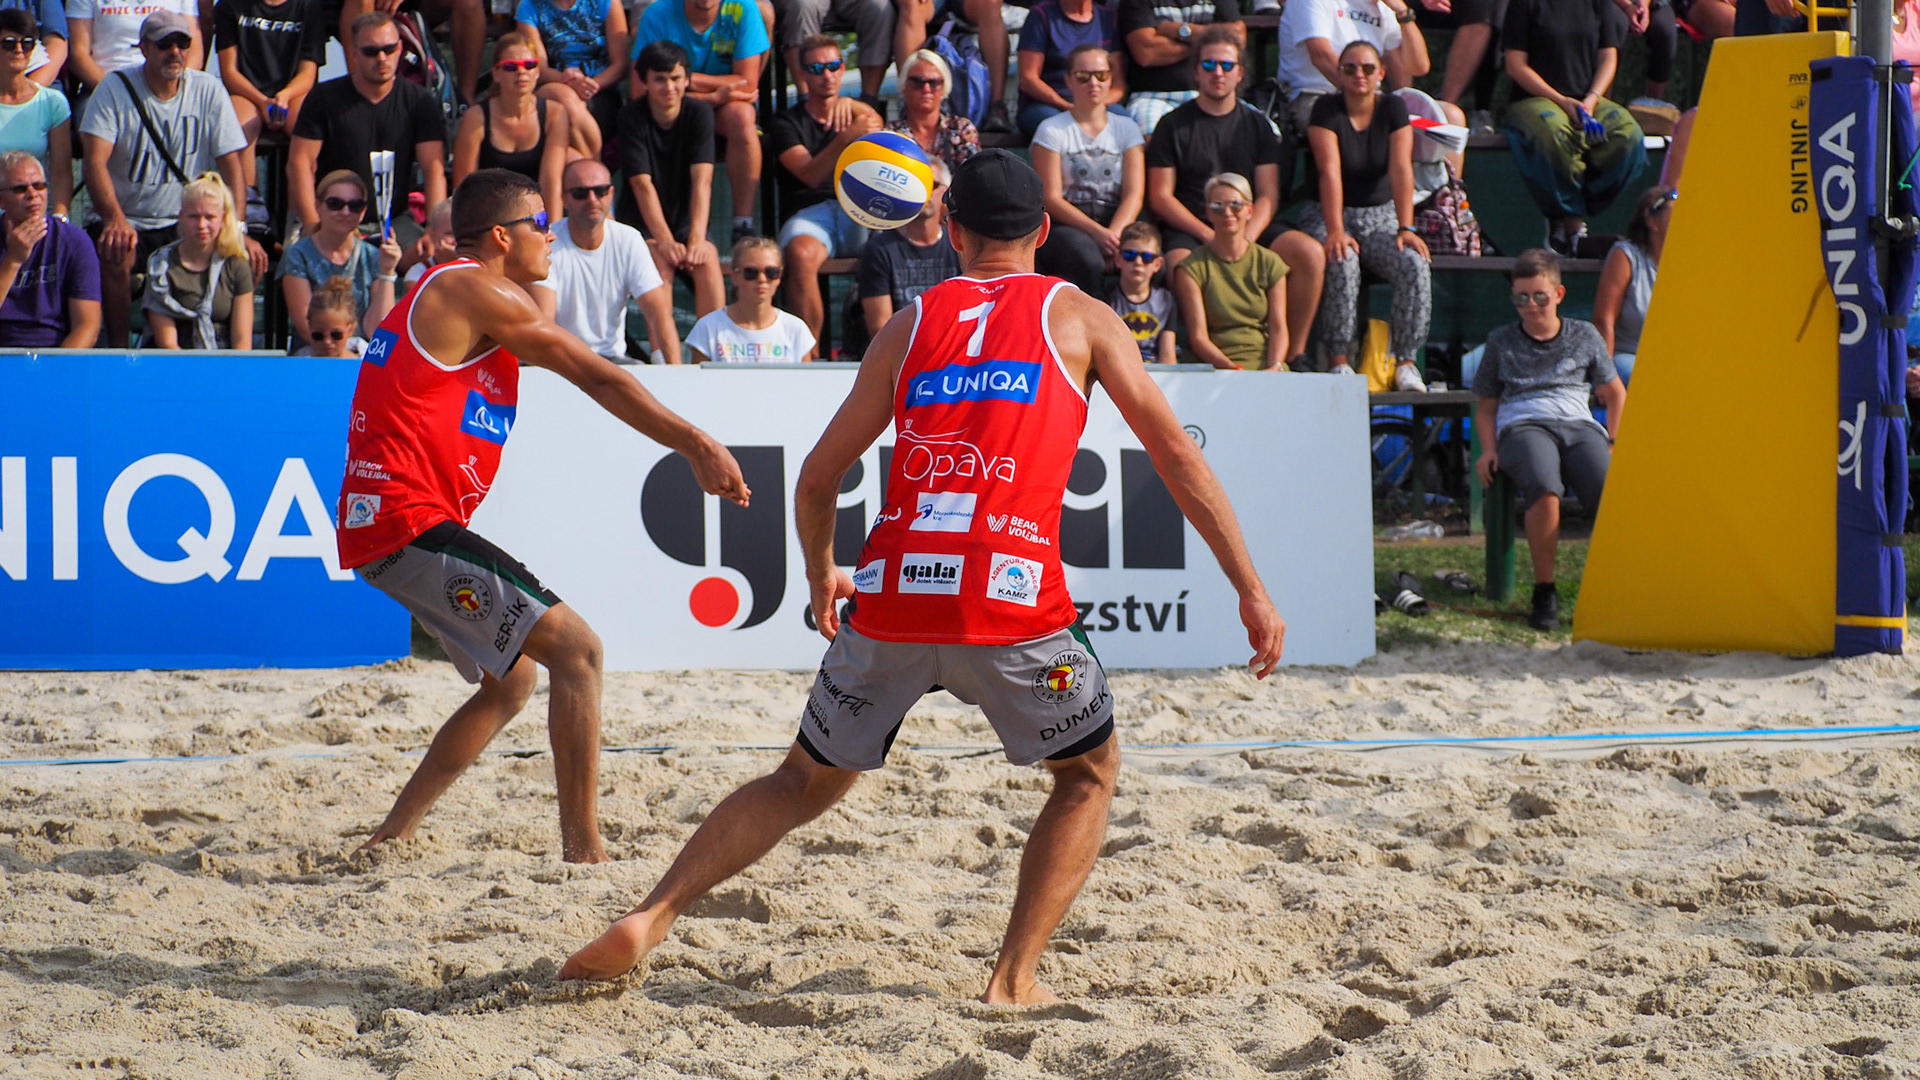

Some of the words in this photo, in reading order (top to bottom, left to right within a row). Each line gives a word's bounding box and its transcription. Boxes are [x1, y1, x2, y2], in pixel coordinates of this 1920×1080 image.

[101, 7, 130, 15] PRIZE
[1791, 119, 1808, 213] JINLING
[1819, 112, 1868, 345] UNIQA
[942, 370, 1029, 395] UNIQA
[903, 443, 1016, 488] Opava
[903, 562, 957, 583] gala
[997, 587, 1029, 600] KAMIZ
[1046, 671, 1086, 702] PRAHA
[1039, 684, 1109, 741] DUMEK
